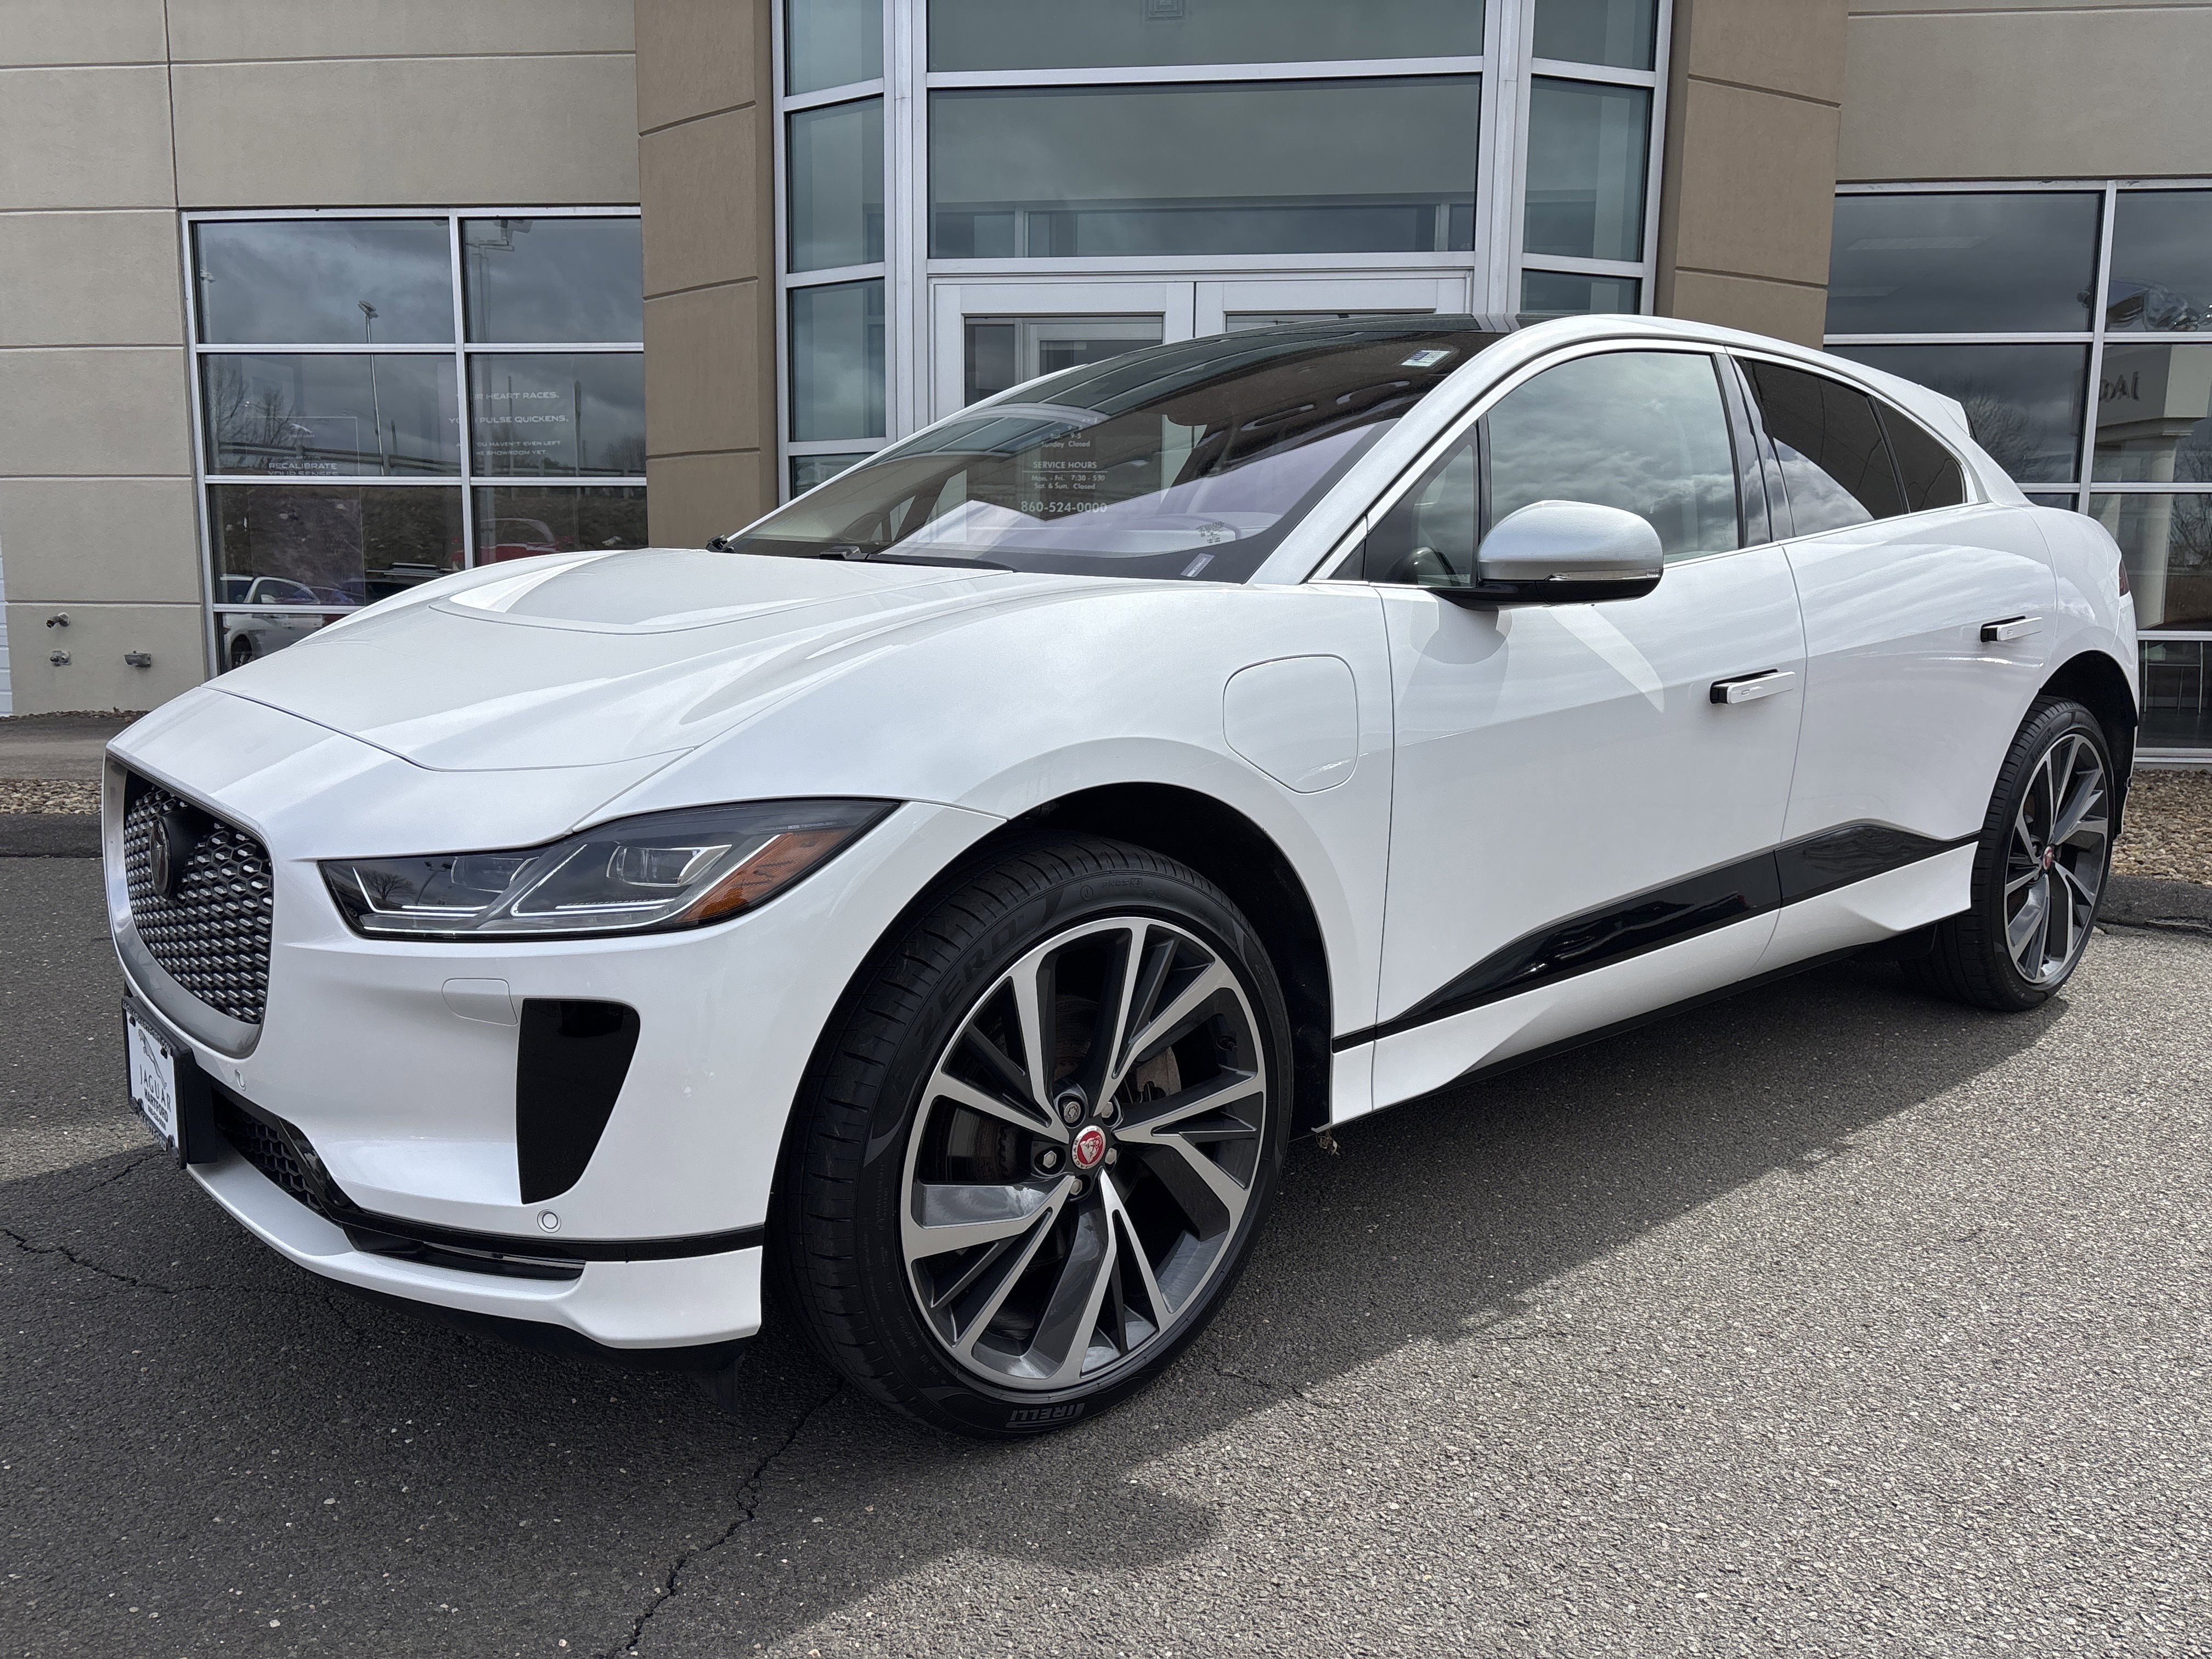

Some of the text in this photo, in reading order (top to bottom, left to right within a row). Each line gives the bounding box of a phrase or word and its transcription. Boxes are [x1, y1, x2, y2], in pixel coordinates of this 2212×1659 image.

[515, 415, 569, 424] QUICKENS.
[1021, 500, 1108, 513] 860-524-0000
[139, 1064, 171, 1113] JAGUAR
[144, 1087, 168, 1123] HARTFORD
[1005, 1402, 1085, 1428] PIRELLI
